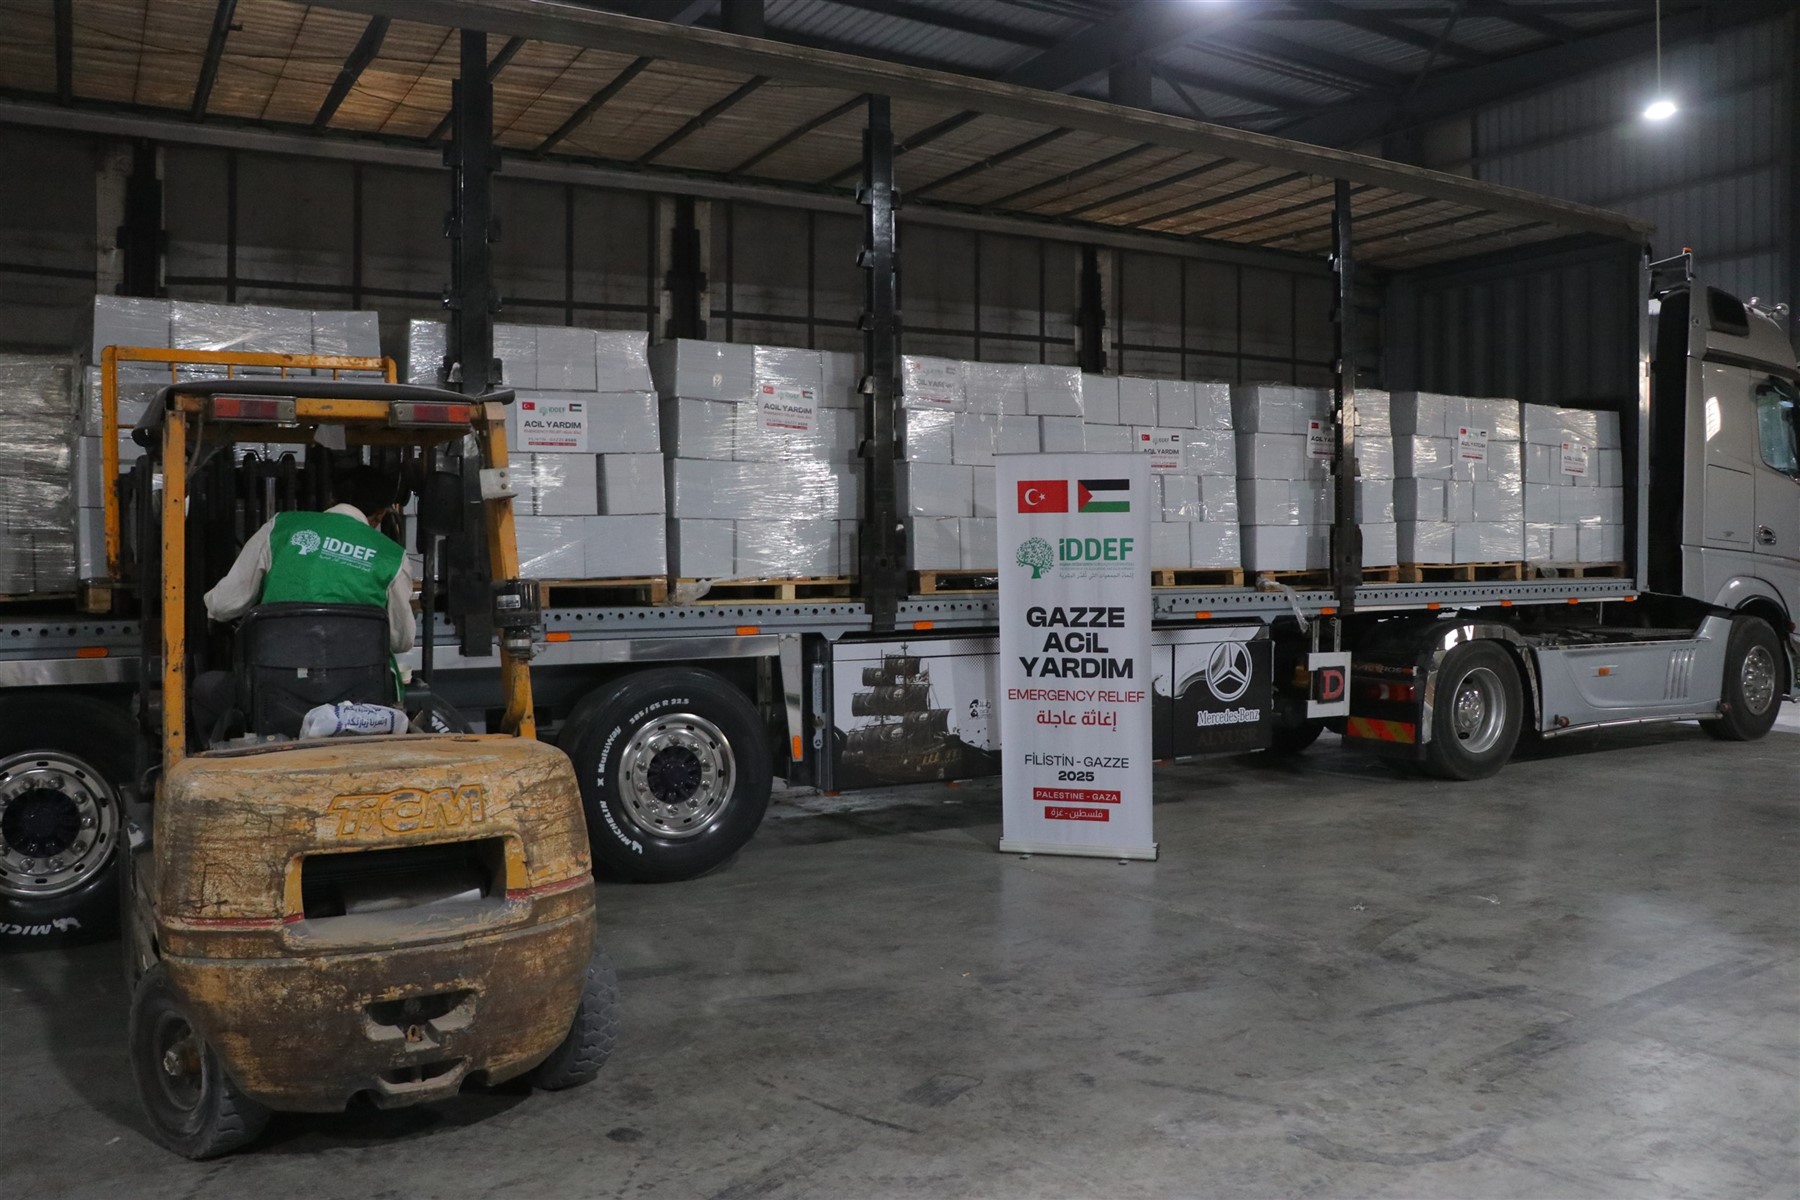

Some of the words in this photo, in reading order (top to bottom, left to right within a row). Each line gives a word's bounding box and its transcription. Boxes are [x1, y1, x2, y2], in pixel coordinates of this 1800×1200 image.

[782, 404, 812, 414] YARDIM
[546, 421, 582, 429] YARDIM
[1026, 606, 1125, 628] GAZZE
[1019, 656, 1133, 679] YARDIM
[1322, 669, 1345, 700] D
[1008, 689, 1095, 703] EMERGENCY
[1098, 690, 1145, 703] RELIEF
[1036, 709, 1077, 729] عاجلة
[1081, 709, 1117, 732] إغاثة
[1197, 707, 1260, 726] Mercedes-Benz
[1024, 751, 1074, 768] FİLİSTİN
[1083, 756, 1129, 769] GAZZE
[1057, 770, 1095, 782] 2025
[1036, 790, 1085, 800] PALESTINE
[1091, 793, 1118, 802] GAZA
[328, 784, 485, 837] TCM
[1050, 807, 1063, 818] غزة
[1069, 808, 1103, 819] فلسطين
[599, 800, 631, 847] MICHELIN
